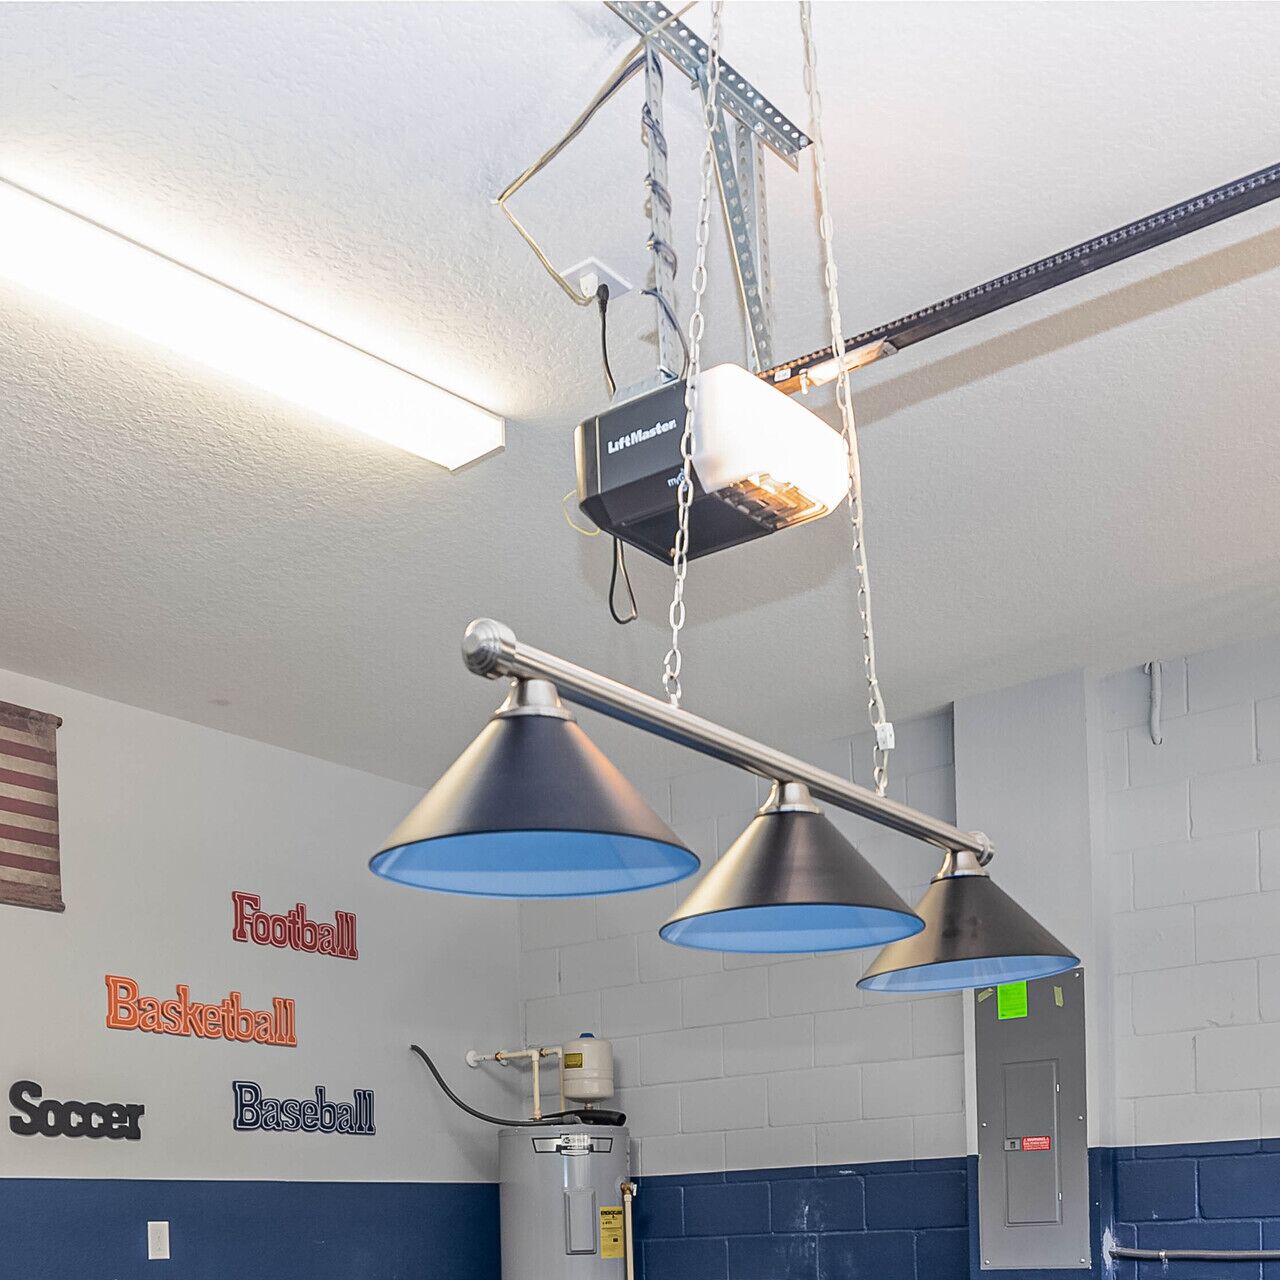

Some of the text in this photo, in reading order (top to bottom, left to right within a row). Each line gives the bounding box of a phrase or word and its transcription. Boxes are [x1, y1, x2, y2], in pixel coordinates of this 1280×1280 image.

[606, 417, 677, 455] LiftMaster
[231, 890, 359, 960] Football
[104, 974, 298, 1048] Basketball
[8, 1080, 146, 1141] Soccer
[231, 1080, 377, 1136] Baseball
